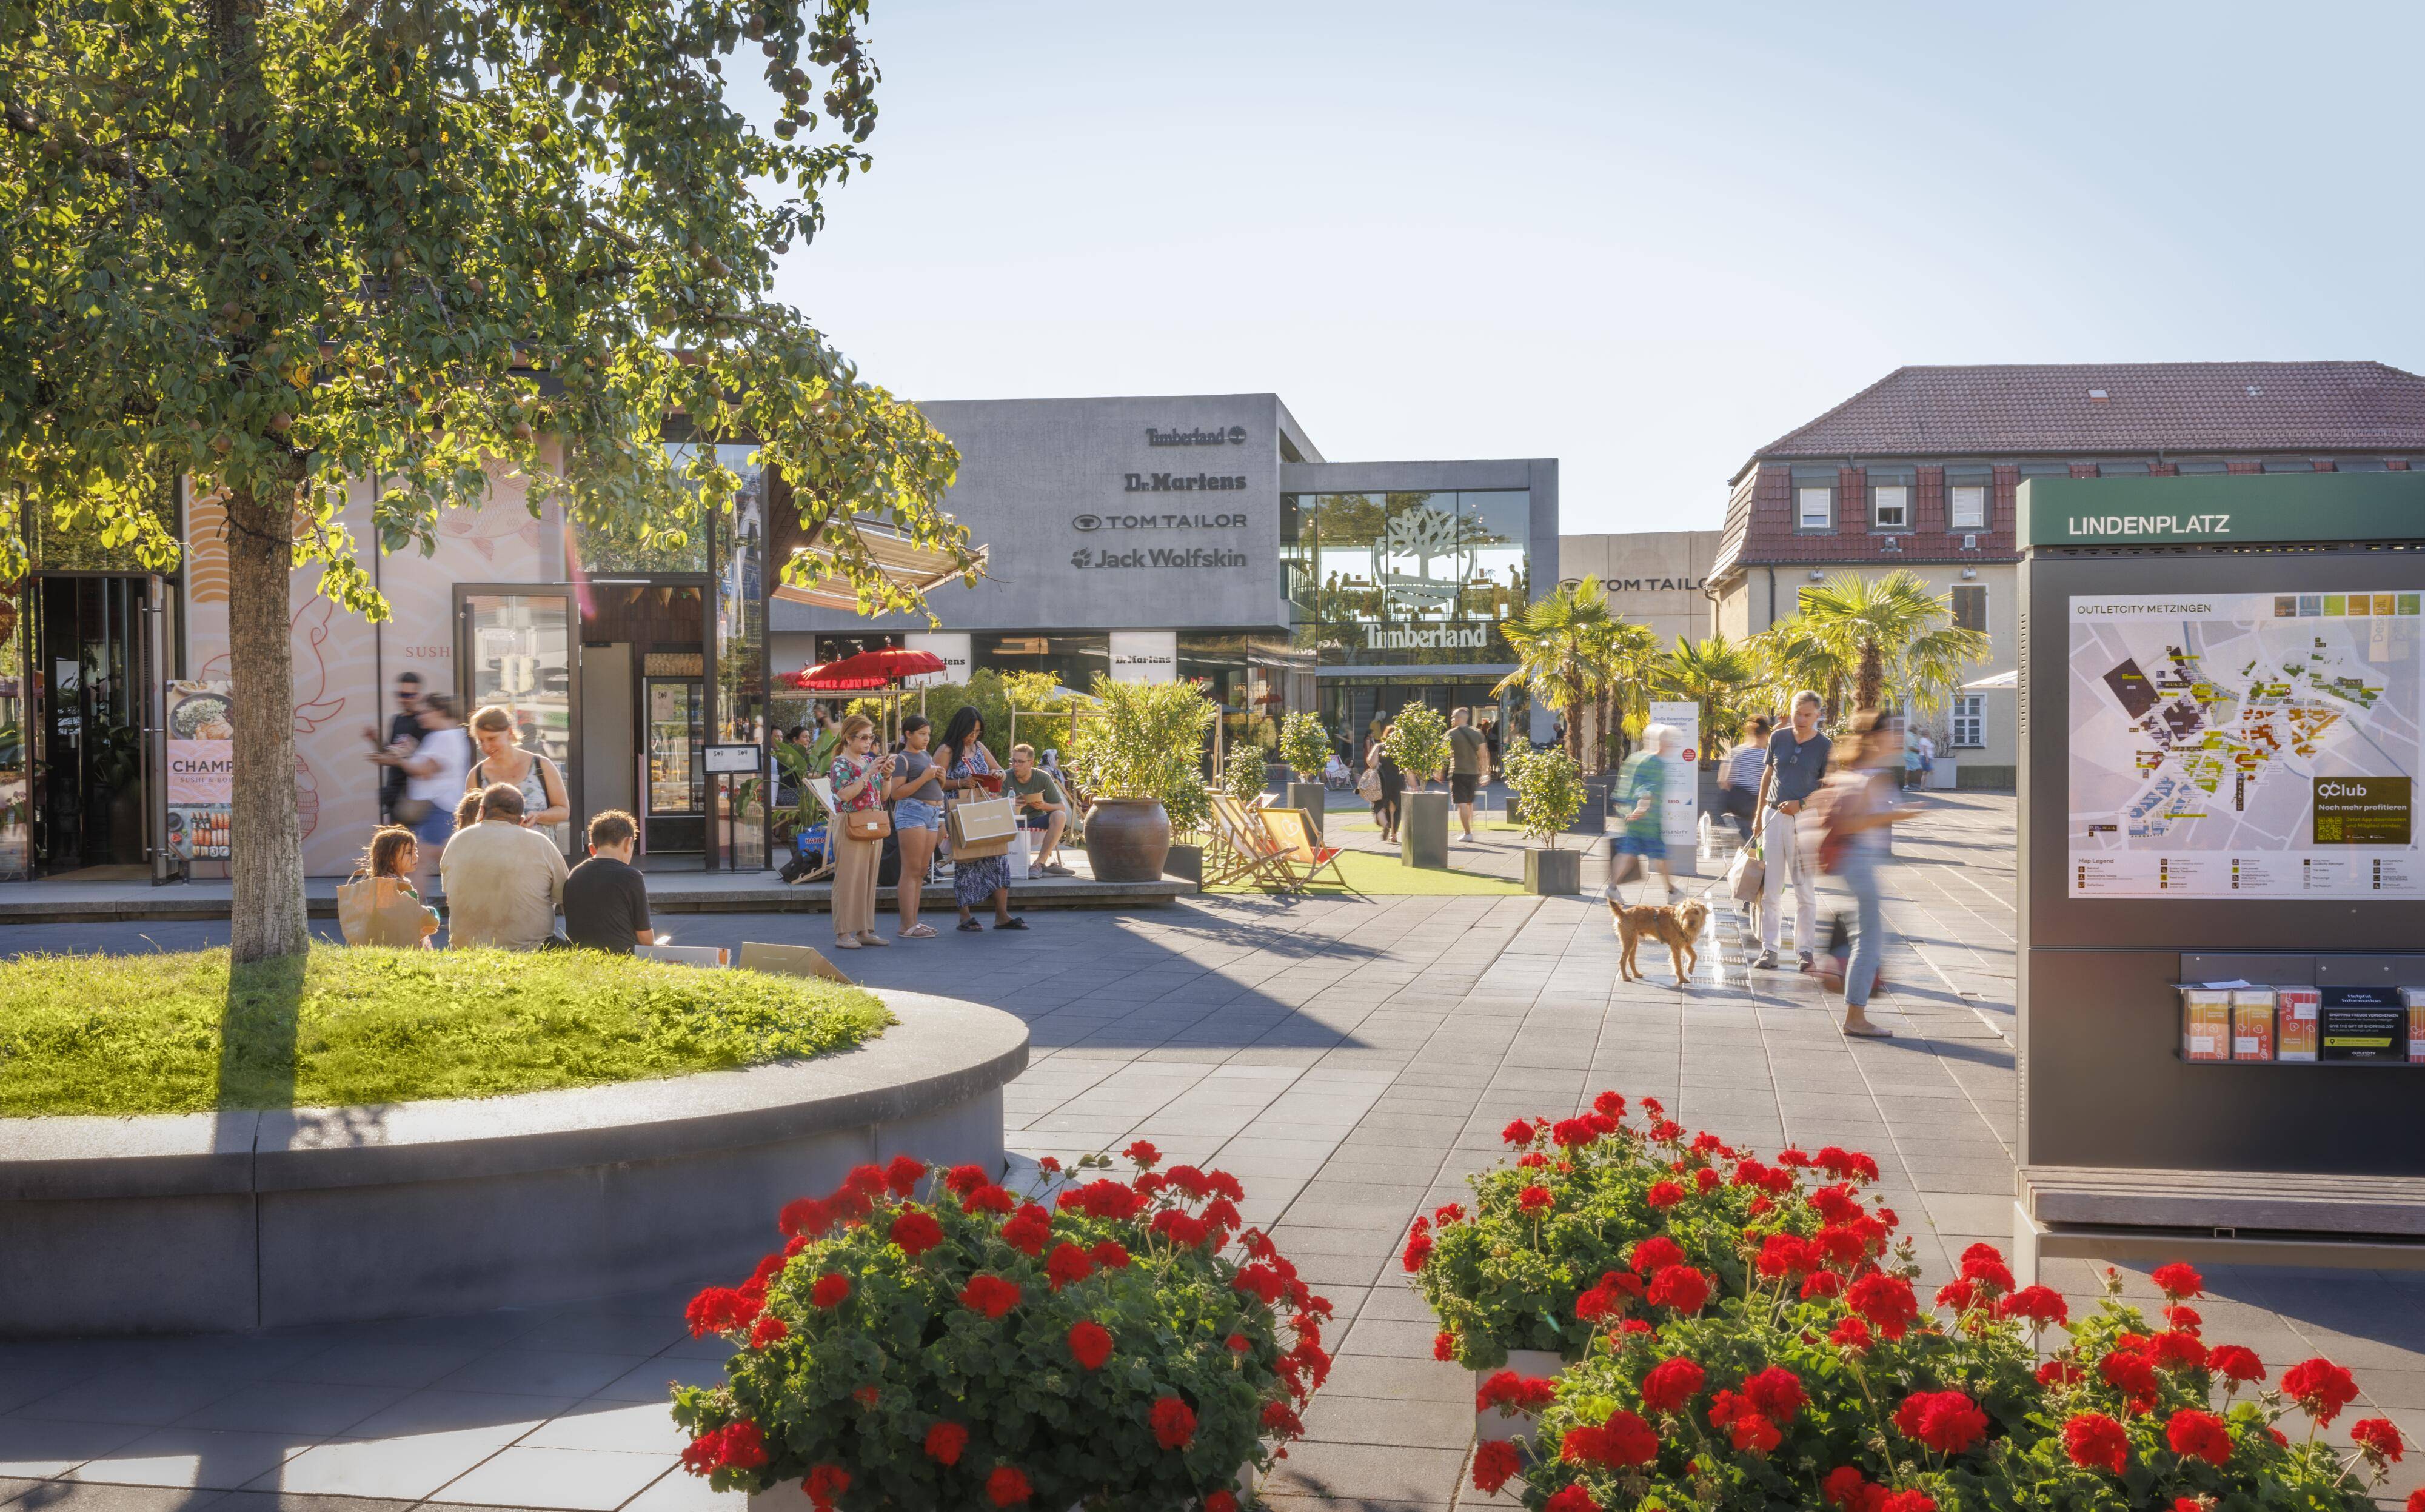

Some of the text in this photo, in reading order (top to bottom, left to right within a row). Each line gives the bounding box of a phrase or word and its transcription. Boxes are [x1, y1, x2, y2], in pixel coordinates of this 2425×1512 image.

[1146, 426, 1225, 446] Timberland
[1106, 515, 1157, 529] TOM
[1162, 514, 1247, 527] TAILOR
[2069, 515, 2230, 535] LINDENPLATZ
[1095, 547, 1246, 567] Jack Wolfskin
[1645, 577, 1708, 590] TAILO
[2077, 603, 2212, 614] OUTLETCITY METZINGEN
[1362, 622, 1487, 649] Timberland
[406, 646, 450, 658] SUSH
[173, 760, 233, 772] CHAMP
[2364, 803, 2407, 812] profitieren
